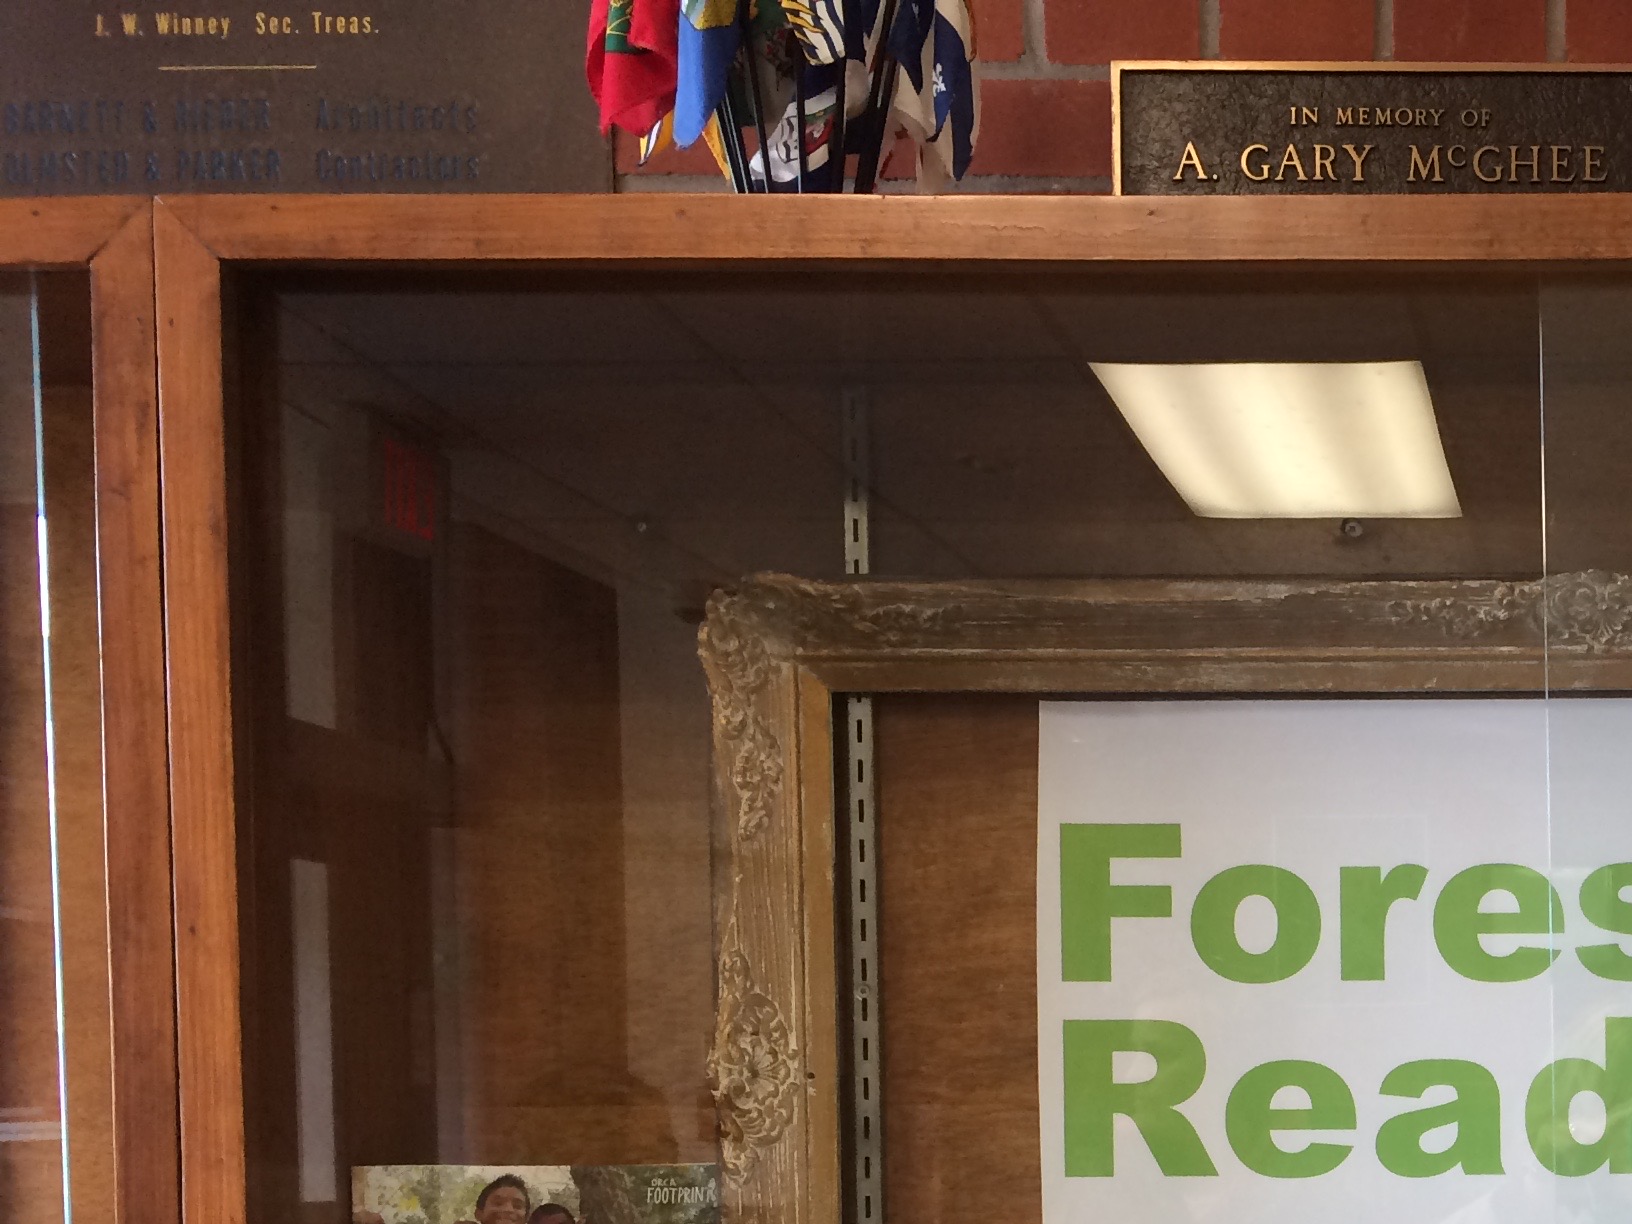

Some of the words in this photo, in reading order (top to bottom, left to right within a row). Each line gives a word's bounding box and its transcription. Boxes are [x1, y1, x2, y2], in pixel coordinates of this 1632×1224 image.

[155, 12, 231, 40] Winney
[255, 11, 299, 35] Sec.
[312, 11, 379, 35] Treas.
[1289, 105, 1319, 128] IN
[1335, 105, 1445, 128] MEMORY
[1460, 107, 1493, 128] OF
[1172, 140, 1219, 182] A.
[1240, 142, 1375, 183] GARY
[1408, 144, 1609, 184] McGHEE
